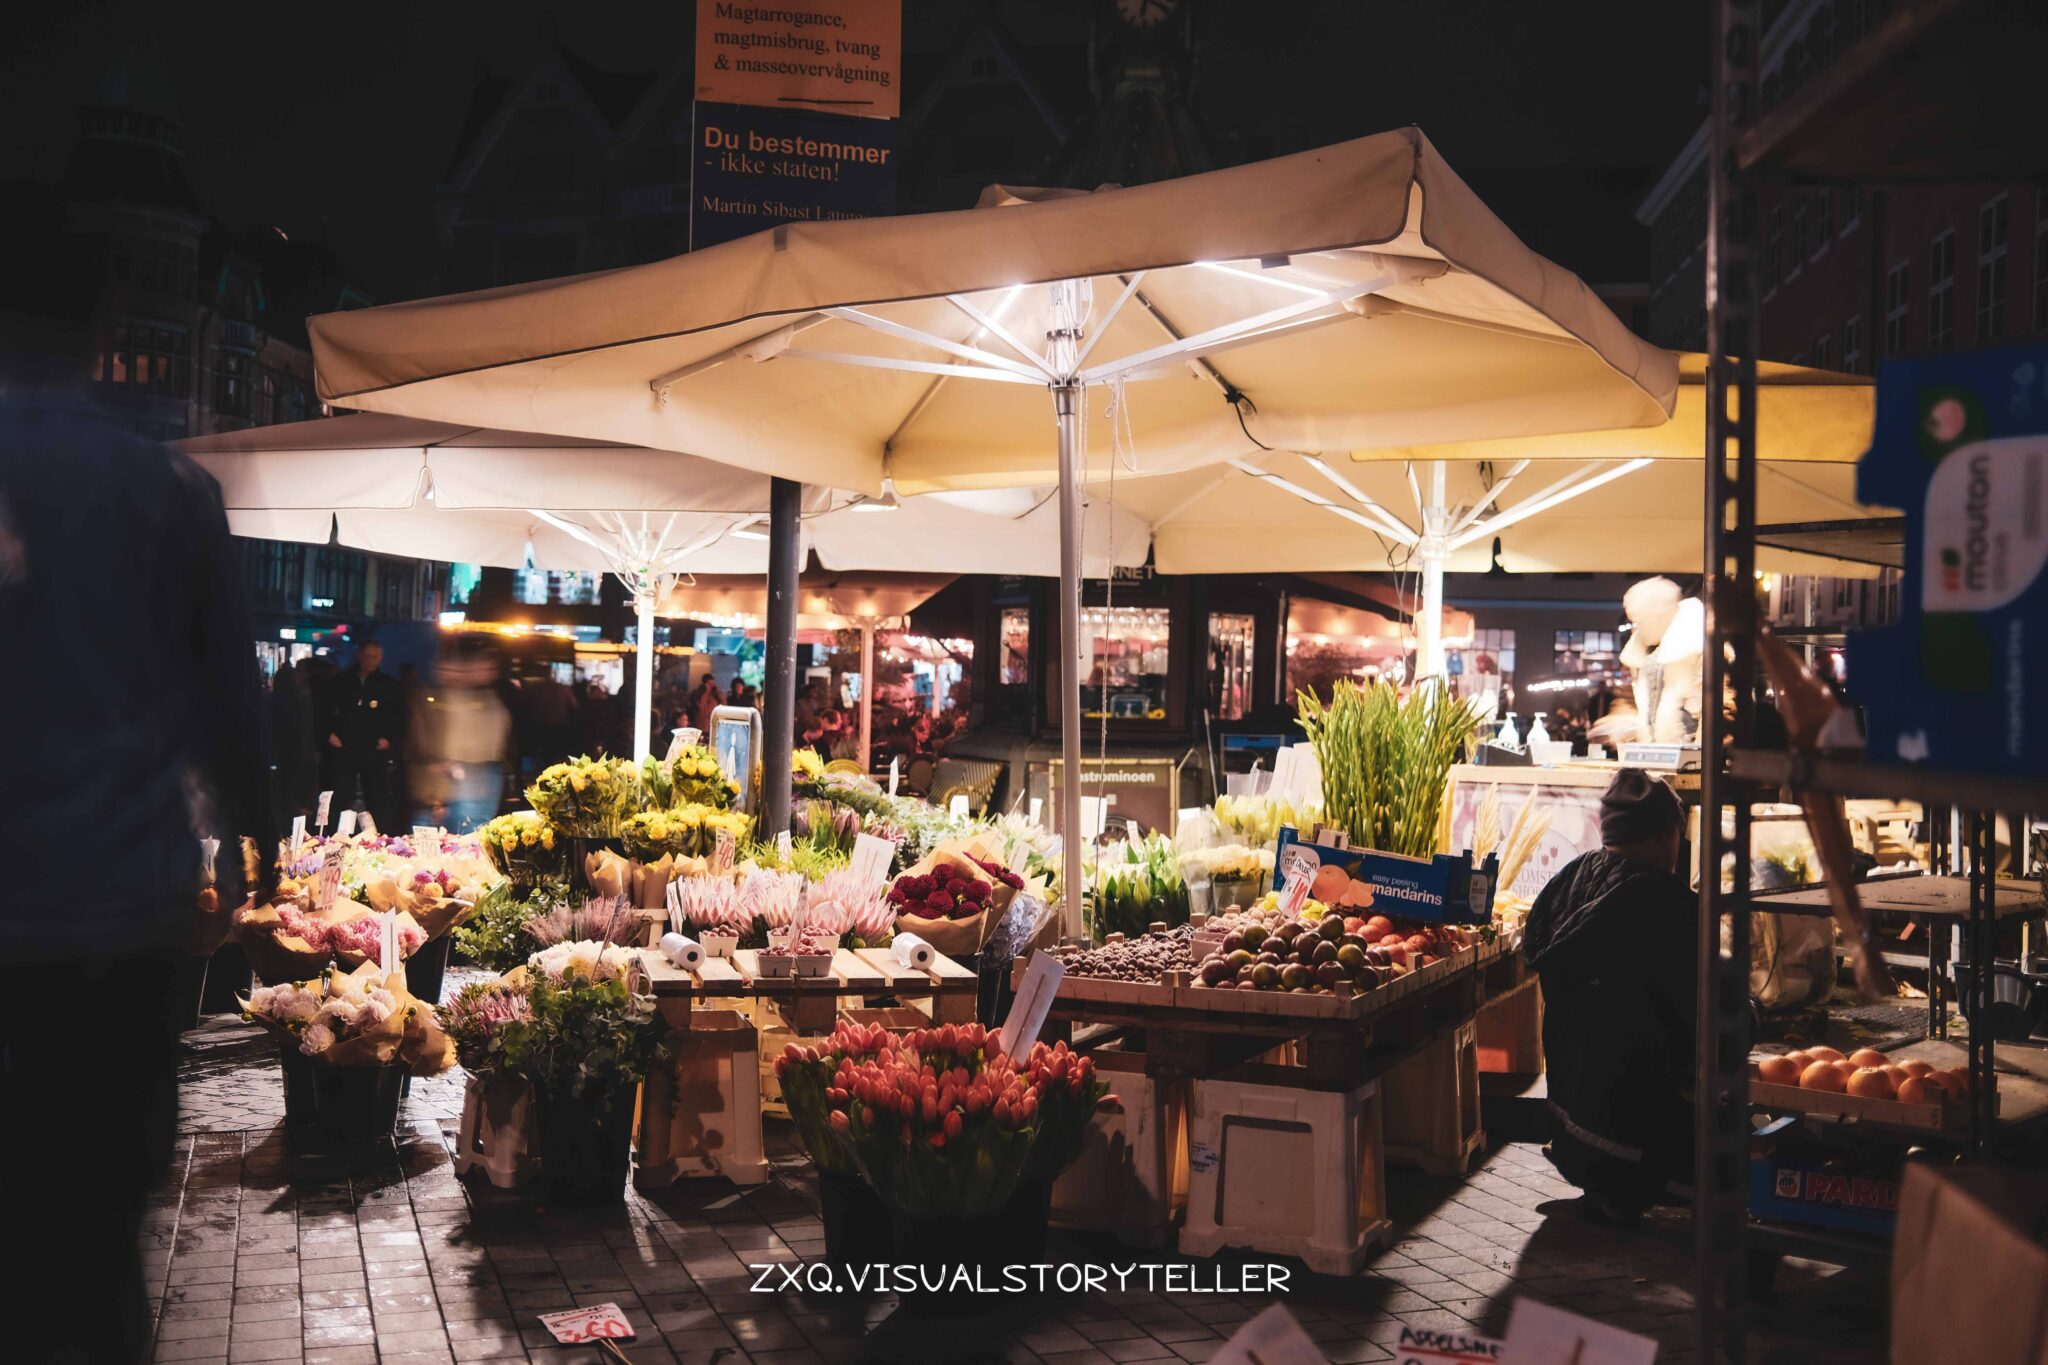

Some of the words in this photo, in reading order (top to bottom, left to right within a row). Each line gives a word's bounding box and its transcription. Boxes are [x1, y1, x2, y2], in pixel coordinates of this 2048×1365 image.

[715, 3, 847, 28] Magtarrogance,
[714, 32, 830, 54] magtmisbrug,
[835, 41, 881, 60] tvang
[714, 54, 730, 71] &
[736, 58, 890, 87] masseovervågning
[705, 126, 739, 150] Du
[750, 130, 890, 165] bestemmer
[721, 151, 765, 175] ikke
[772, 162, 839, 182] staten!
[703, 196, 757, 216] Martin
[762, 199, 809, 220] Sibast
[1964, 453, 1991, 592] mouton
[1371, 884, 1443, 906] mandarins
[1372, 875, 1390, 884] easy
[1391, 879, 1419, 890] peeling
